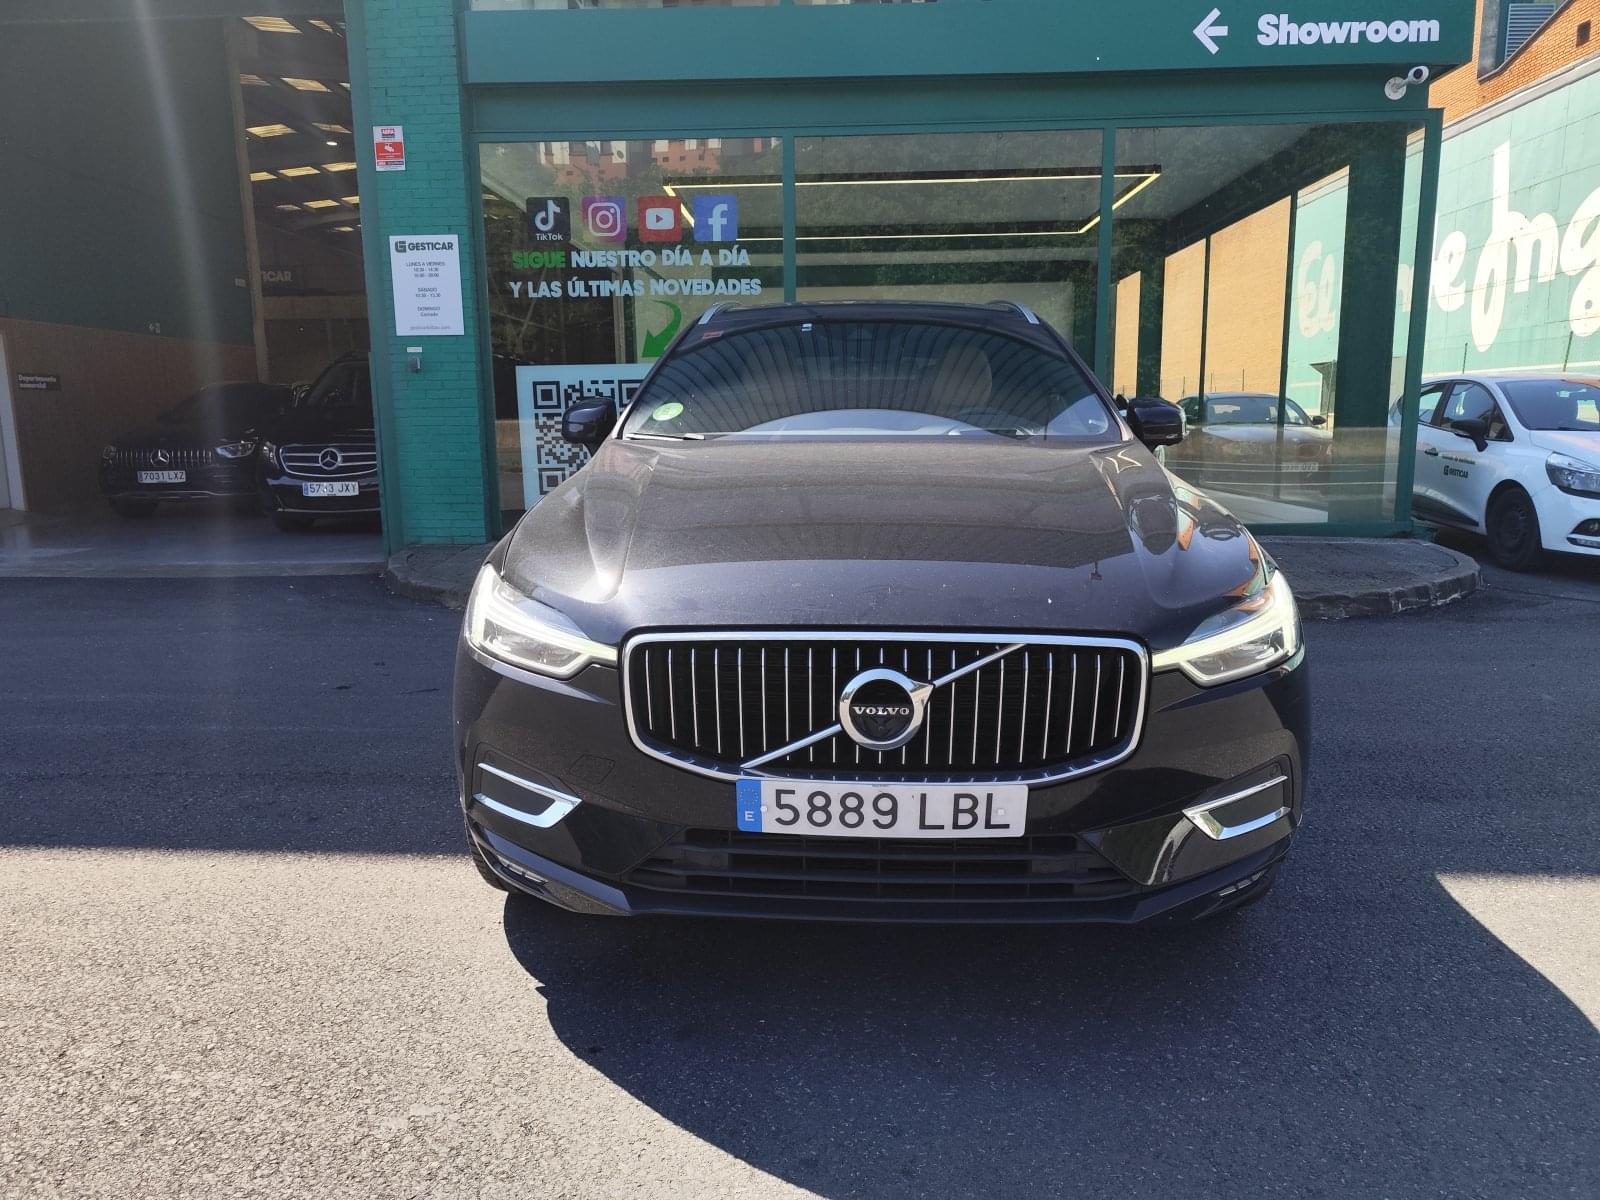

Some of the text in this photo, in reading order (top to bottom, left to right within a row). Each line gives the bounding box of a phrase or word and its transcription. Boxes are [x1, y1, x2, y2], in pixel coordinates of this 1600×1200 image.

[1257, 13, 1440, 46] Showroom
[536, 232, 564, 241] TikTok
[407, 241, 454, 251] GESTICAR
[511, 245, 751, 269] SIGUE NUESTRO DÍA A DÍA
[509, 276, 762, 298] Y LAS ÚLTIMAS NOVEDADES
[143, 471, 185, 481] 7031 LXZ
[337, 483, 358, 493] JXY
[852, 706, 910, 716] VOLVO
[774, 789, 1011, 831] 5889 LBL
[744, 810, 755, 822] E
